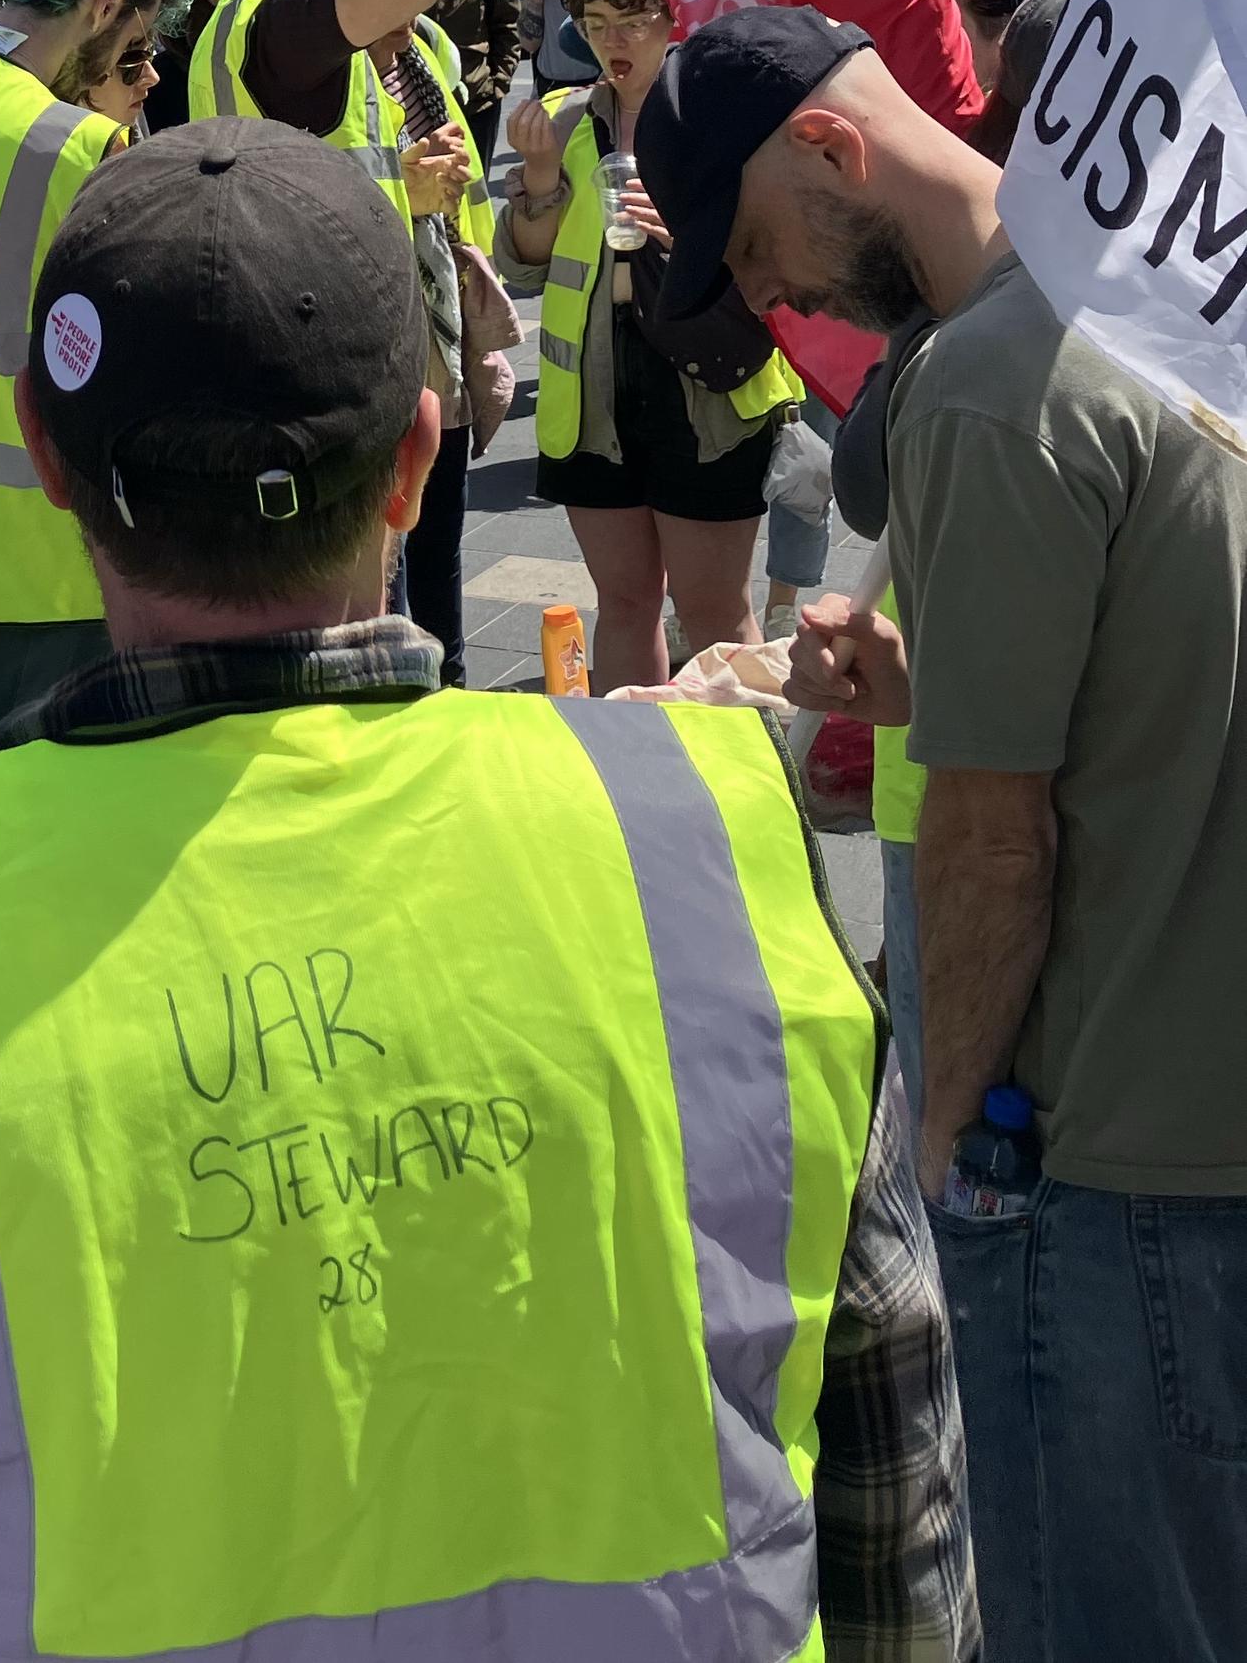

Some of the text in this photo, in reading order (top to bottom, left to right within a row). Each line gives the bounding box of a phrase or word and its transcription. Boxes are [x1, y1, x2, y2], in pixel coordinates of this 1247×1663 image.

[58, 346, 87, 380] PROFIT
[62, 334, 93, 367] BEFORE
[67, 320, 98, 354] PEOPLE
[165, 947, 387, 1105] UAR
[178, 1096, 535, 1242] STEWARD
[318, 1242, 378, 1314] 28
